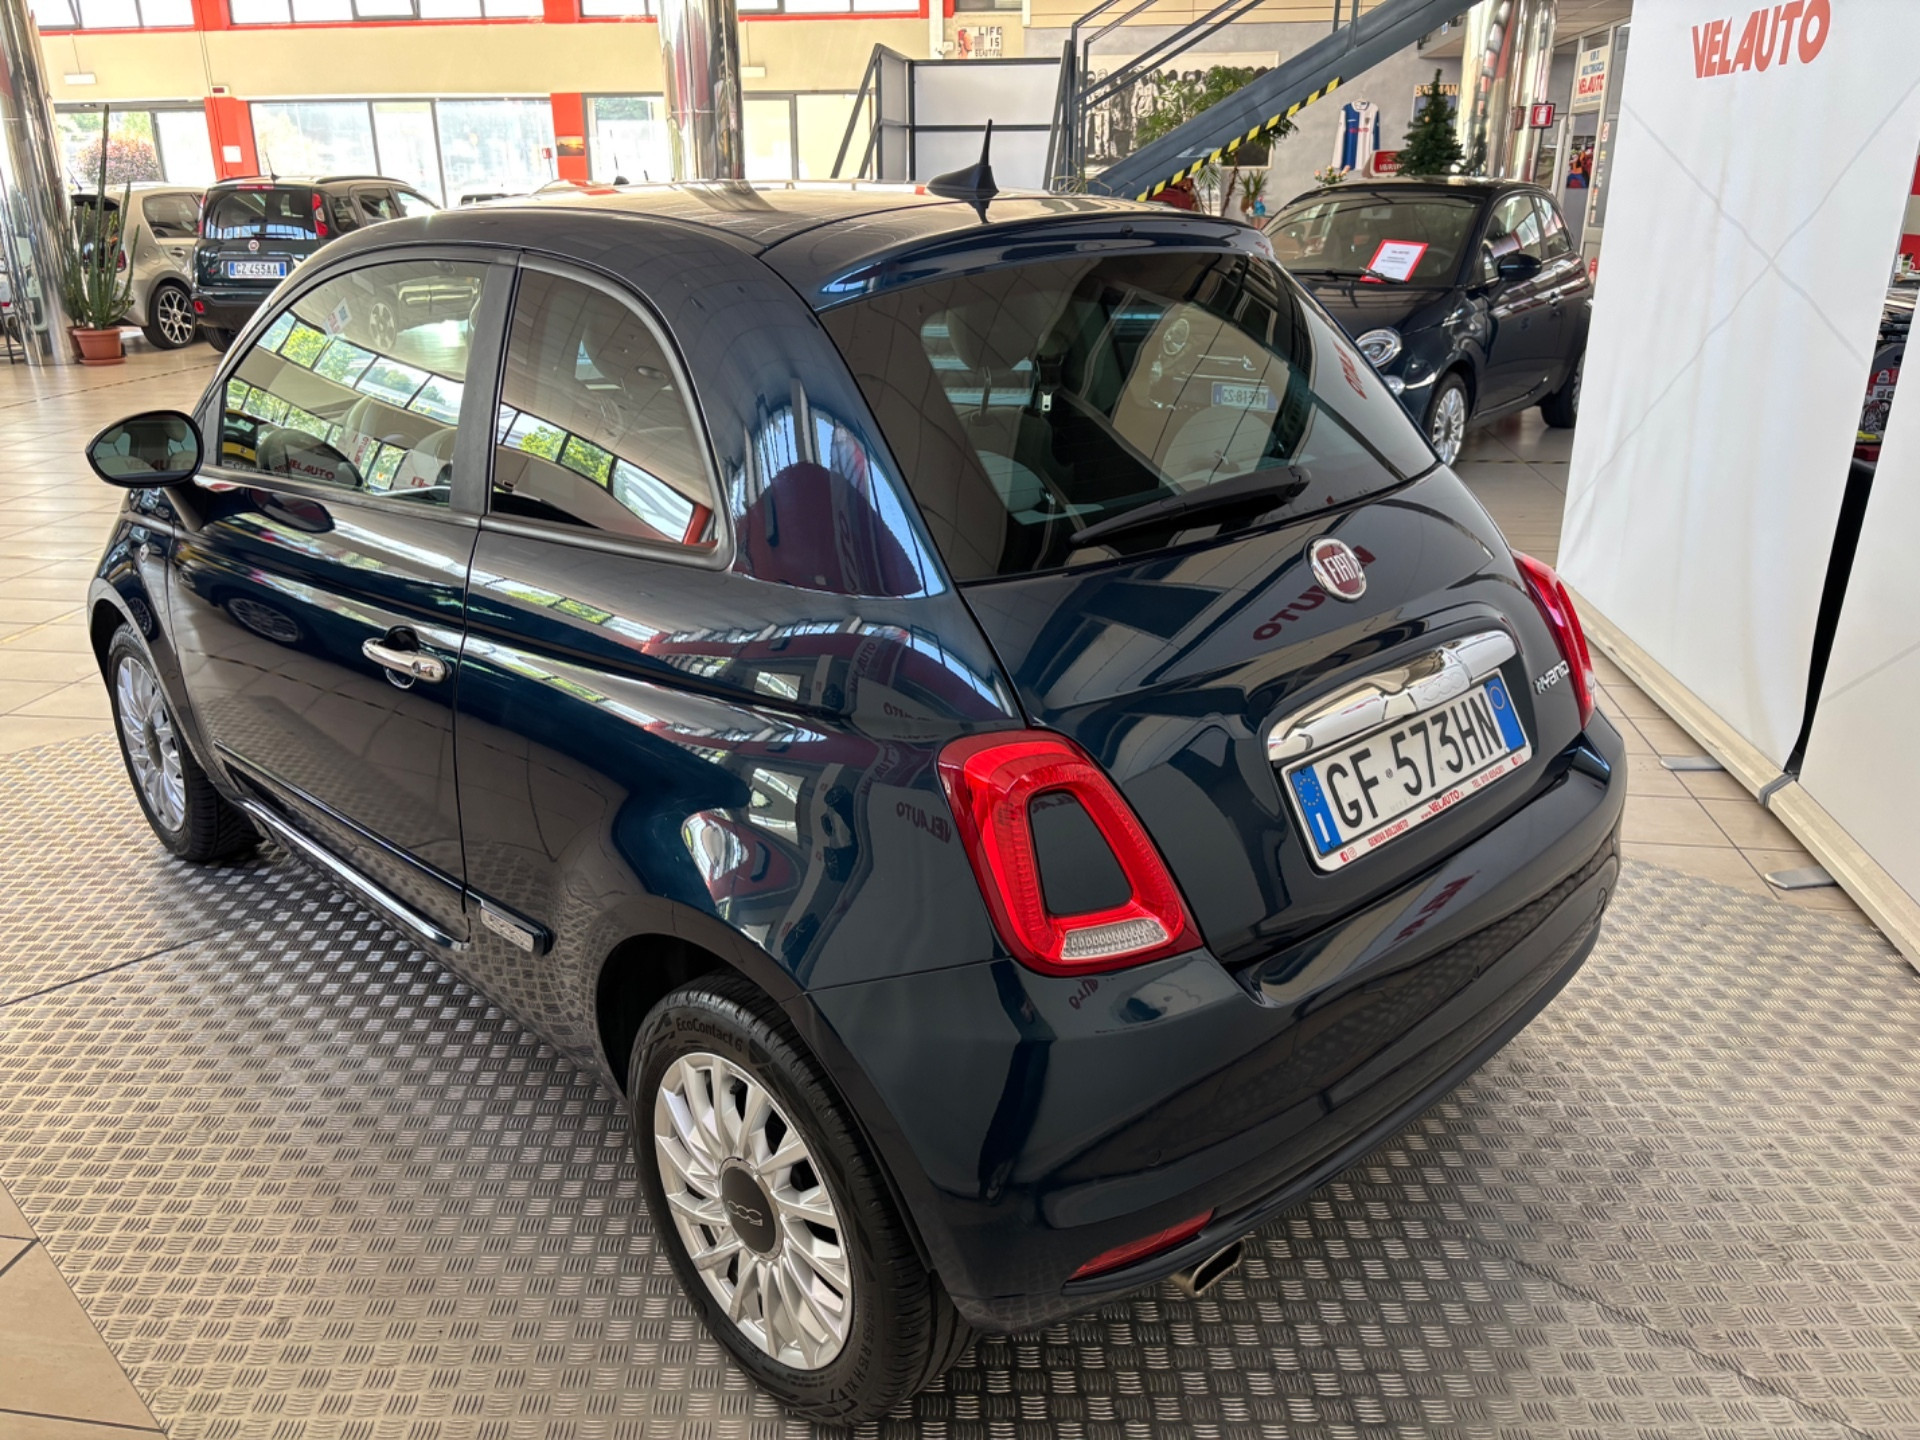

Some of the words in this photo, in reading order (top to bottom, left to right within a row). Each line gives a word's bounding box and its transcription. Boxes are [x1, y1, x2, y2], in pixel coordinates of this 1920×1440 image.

[1691, 0, 1831, 79] VELAUTO
[1323, 553, 1359, 585] FIAT
[675, 1017, 734, 1047] EcoContact
